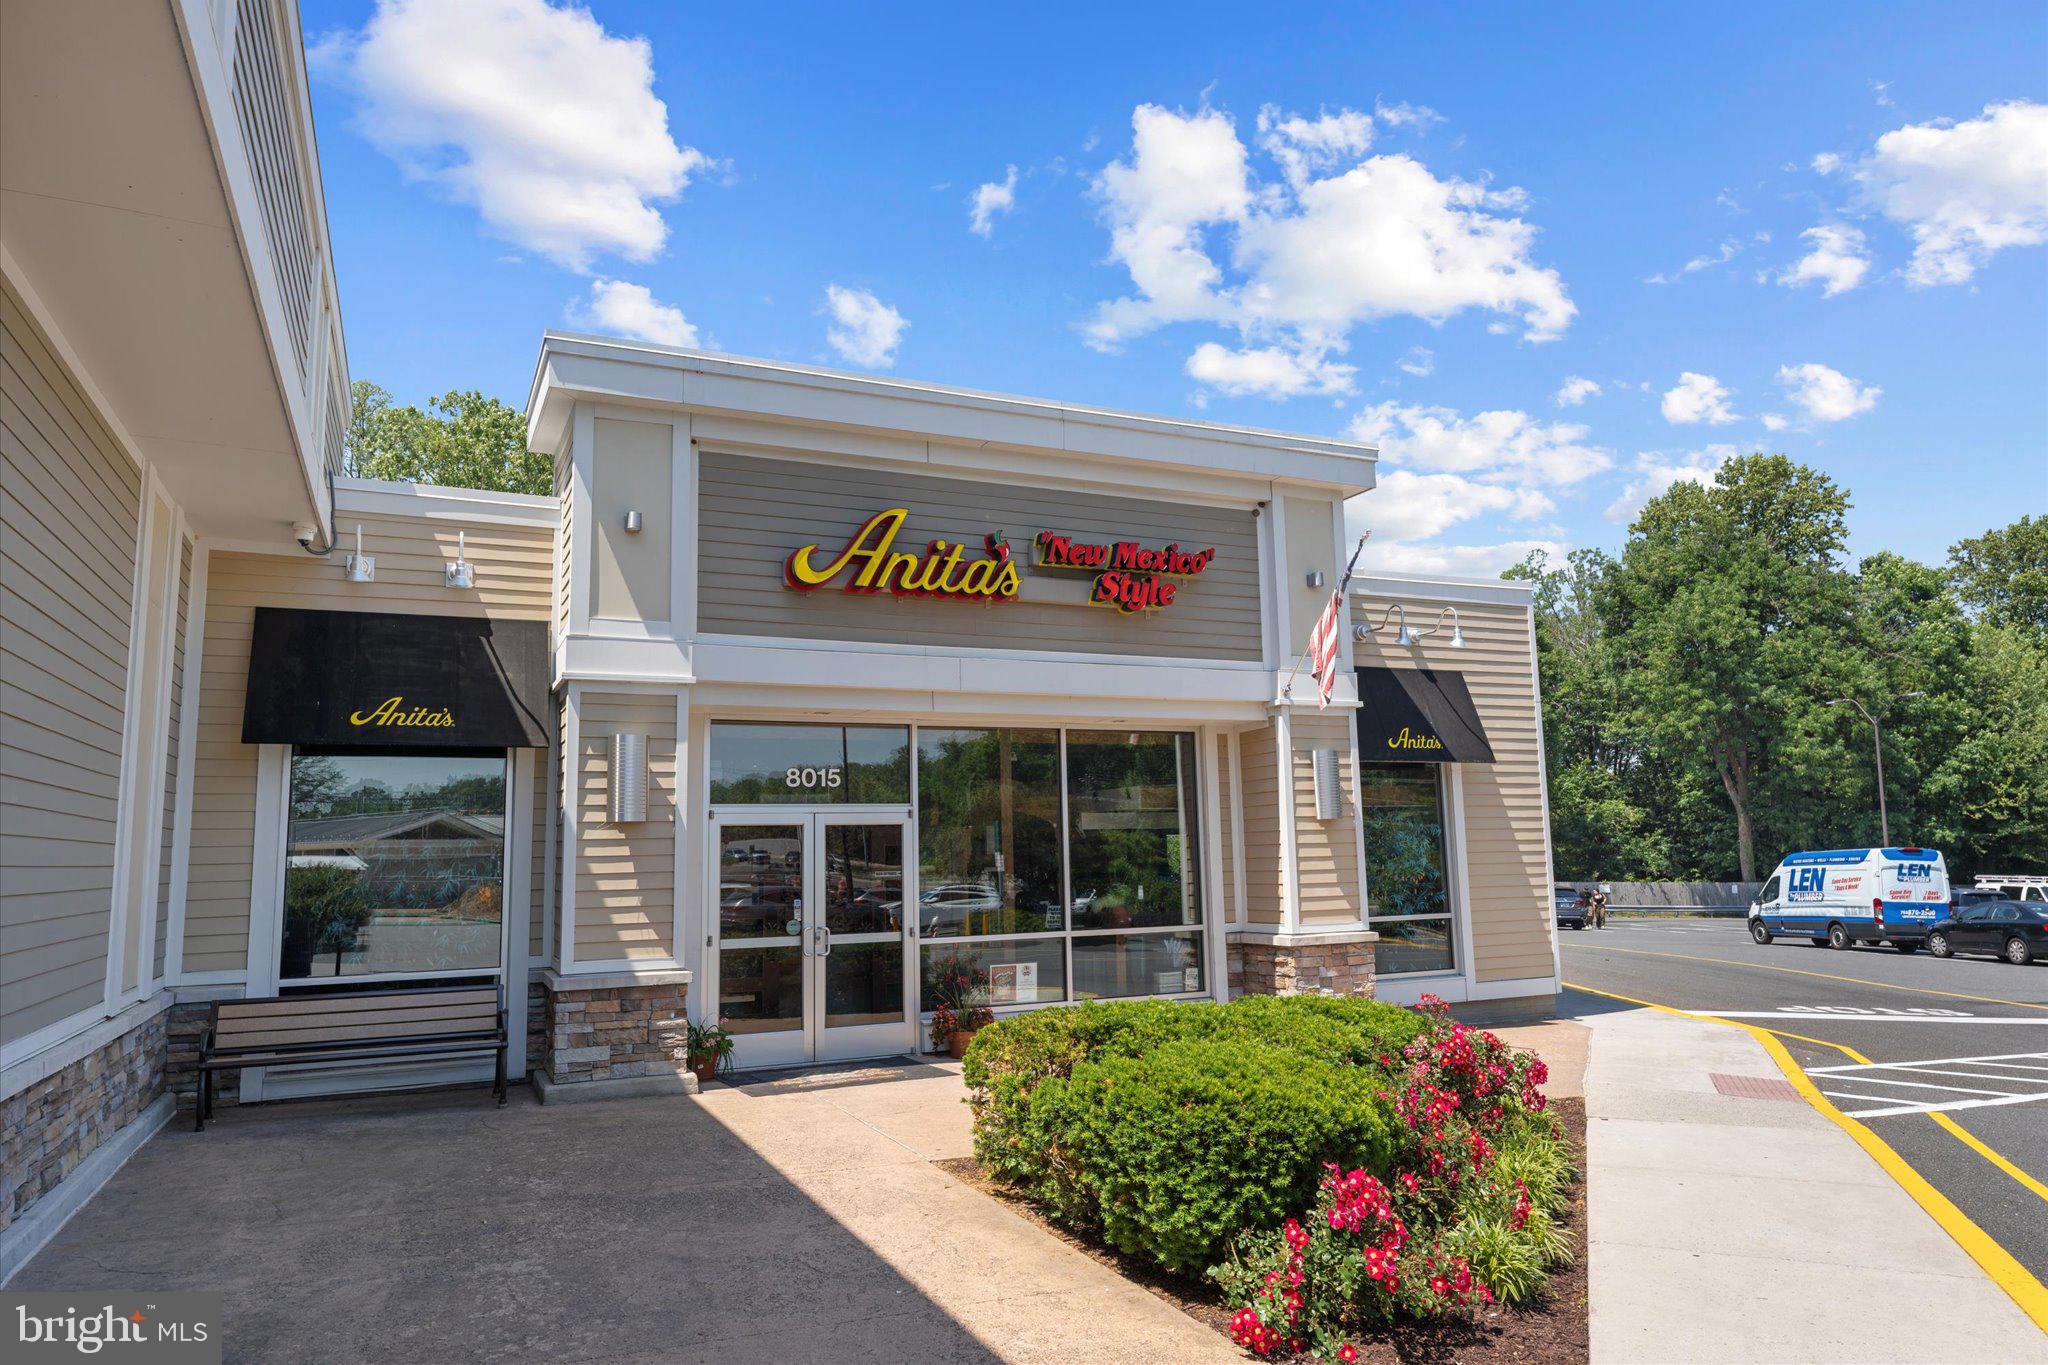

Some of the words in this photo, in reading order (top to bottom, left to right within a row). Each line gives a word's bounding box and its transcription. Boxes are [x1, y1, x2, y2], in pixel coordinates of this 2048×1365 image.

[789, 507, 1024, 599] Anita's
[1095, 571, 1176, 612] Style
[350, 696, 453, 727] Anita's
[1388, 727, 1442, 750] Anita's
[785, 767, 842, 788] 8015
[1789, 867, 1826, 891] LEN
[1897, 864, 1931, 876] LEN
[1794, 892, 1823, 902] PLUMBER
